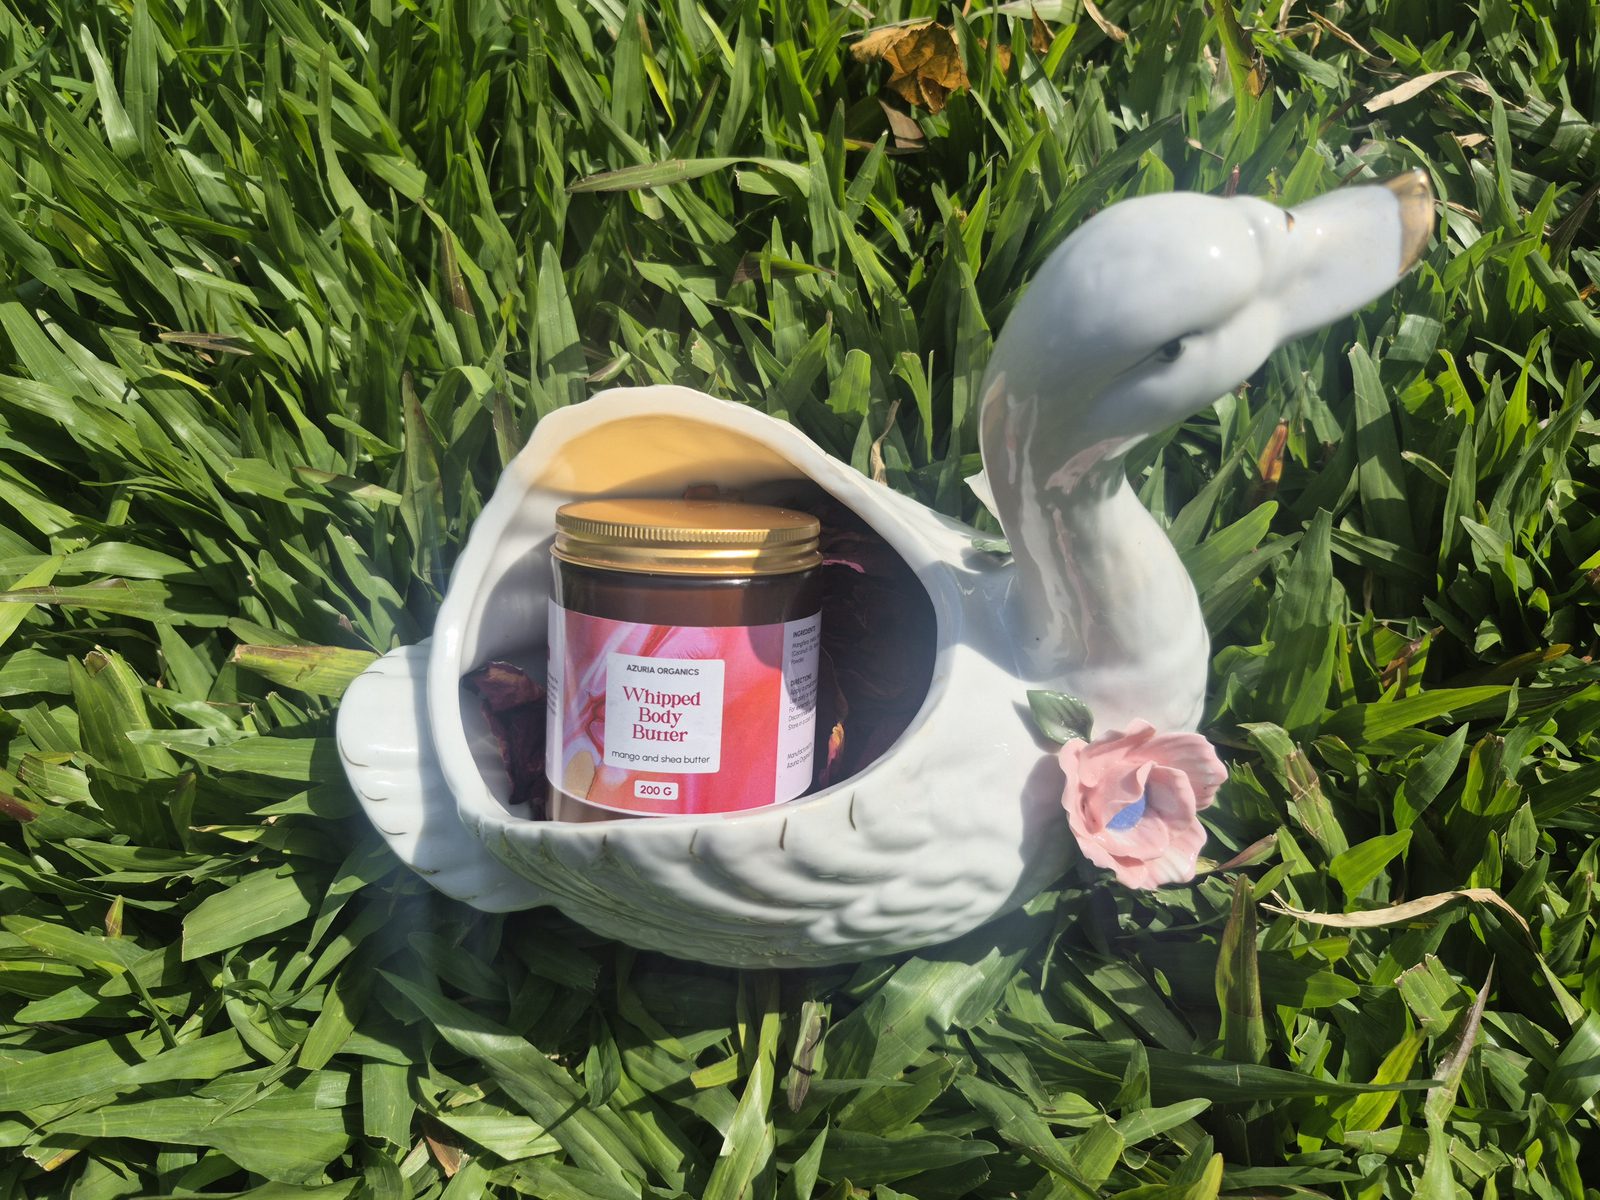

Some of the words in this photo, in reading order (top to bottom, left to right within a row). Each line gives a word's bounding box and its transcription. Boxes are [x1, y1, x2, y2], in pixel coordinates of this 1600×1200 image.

[626, 664, 655, 674] AZURIA
[657, 667, 699, 676] ORGANICS
[622, 685, 701, 708] Whipped
[639, 706, 683, 728] Body
[632, 723, 688, 742] Butter
[611, 750, 640, 762] mango
[642, 754, 659, 763] and
[660, 754, 682, 764] shea
[683, 755, 710, 764] butter
[640, 785, 660, 796] 200
[663, 786, 672, 796] G
